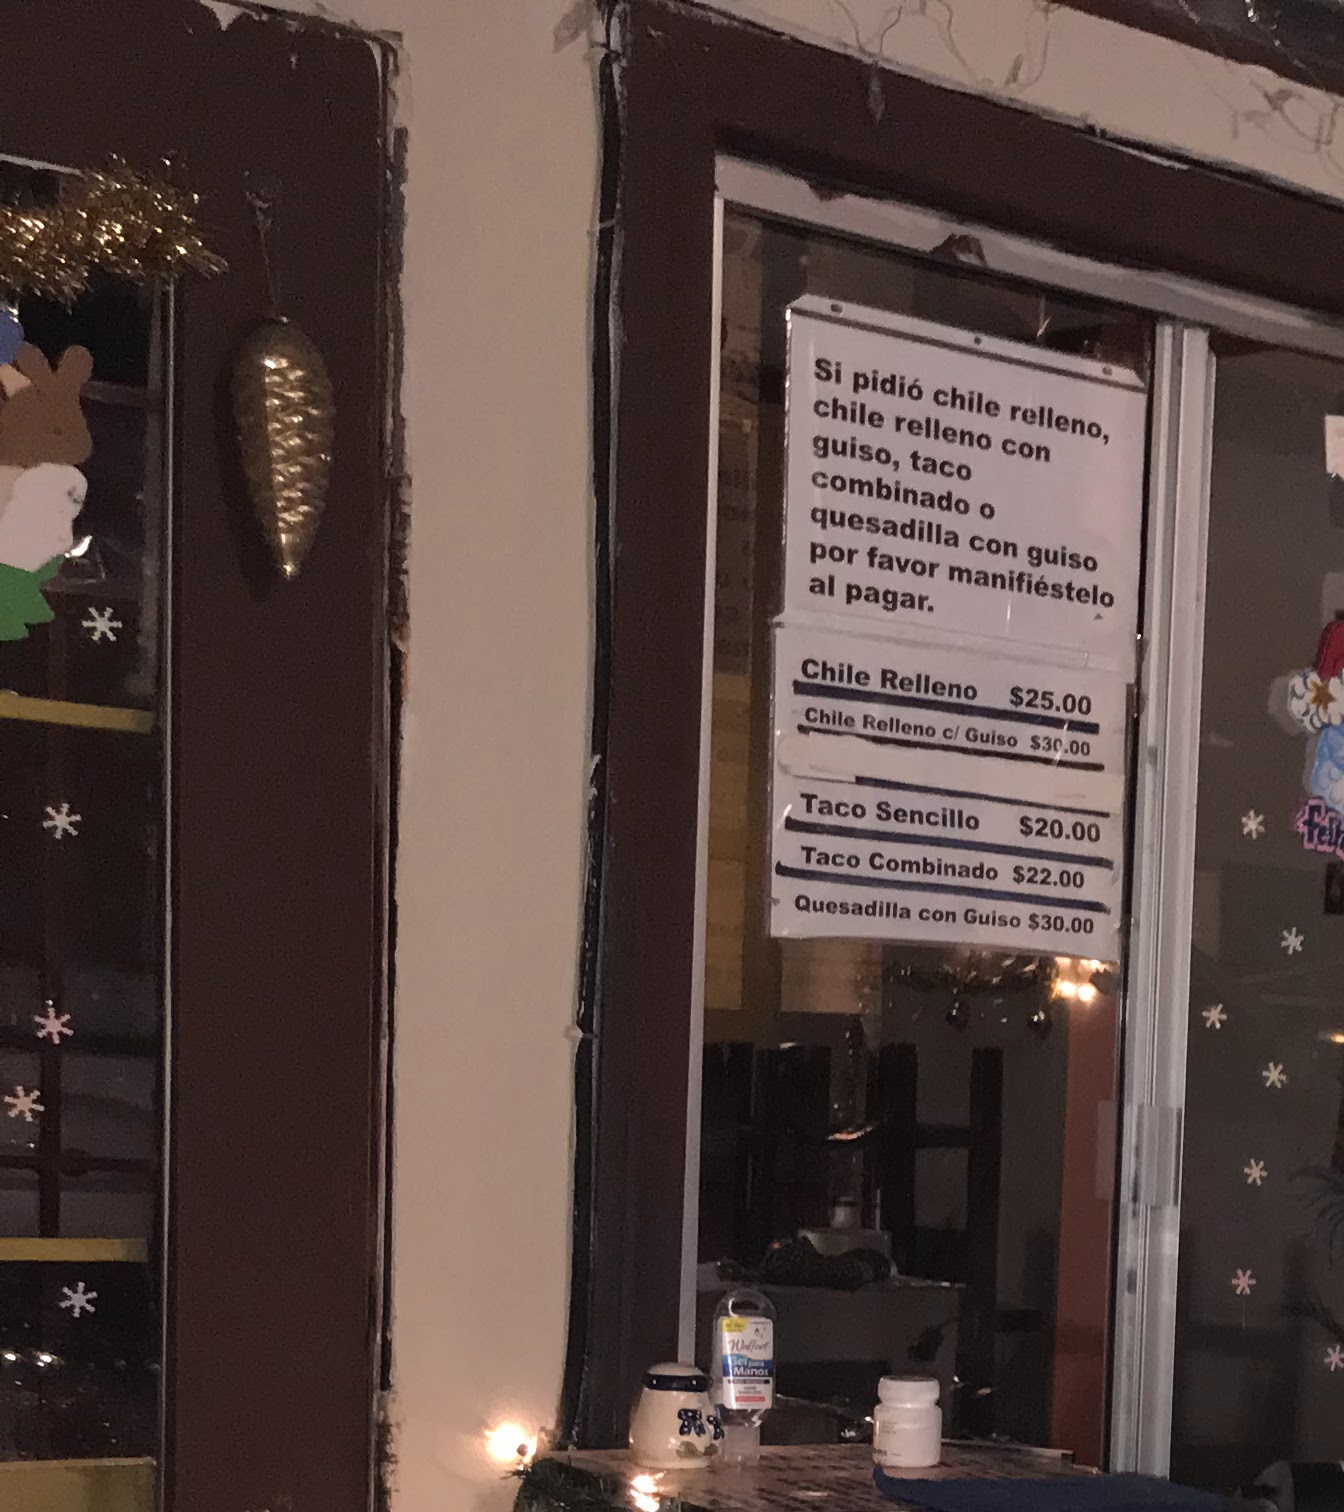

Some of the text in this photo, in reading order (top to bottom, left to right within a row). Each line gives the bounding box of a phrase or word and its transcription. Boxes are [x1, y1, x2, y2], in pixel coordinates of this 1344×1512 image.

[814, 357, 1110, 446] Si pidió chile relleno,
[813, 398, 1052, 463] chile relleno con
[812, 432, 973, 482] guiso, taco
[811, 470, 996, 521] combinado o
[810, 505, 1099, 573] quesadilla con guiso
[809, 540, 1115, 609] por favor manifiéstelo
[809, 575, 935, 614] al pagar.
[801, 657, 1092, 717] Chile Relleno $25.00
[804, 706, 855, 729] Chile
[863, 714, 937, 739] Relleno
[965, 726, 1019, 749] Guiso
[1030, 734, 1091, 757] $30.00
[800, 793, 1101, 843] Taco Sencillo $20.00
[801, 845, 1085, 889] Taco Combinado $22.00
[795, 894, 1095, 935] Quesadilla con Guiso $30.00
